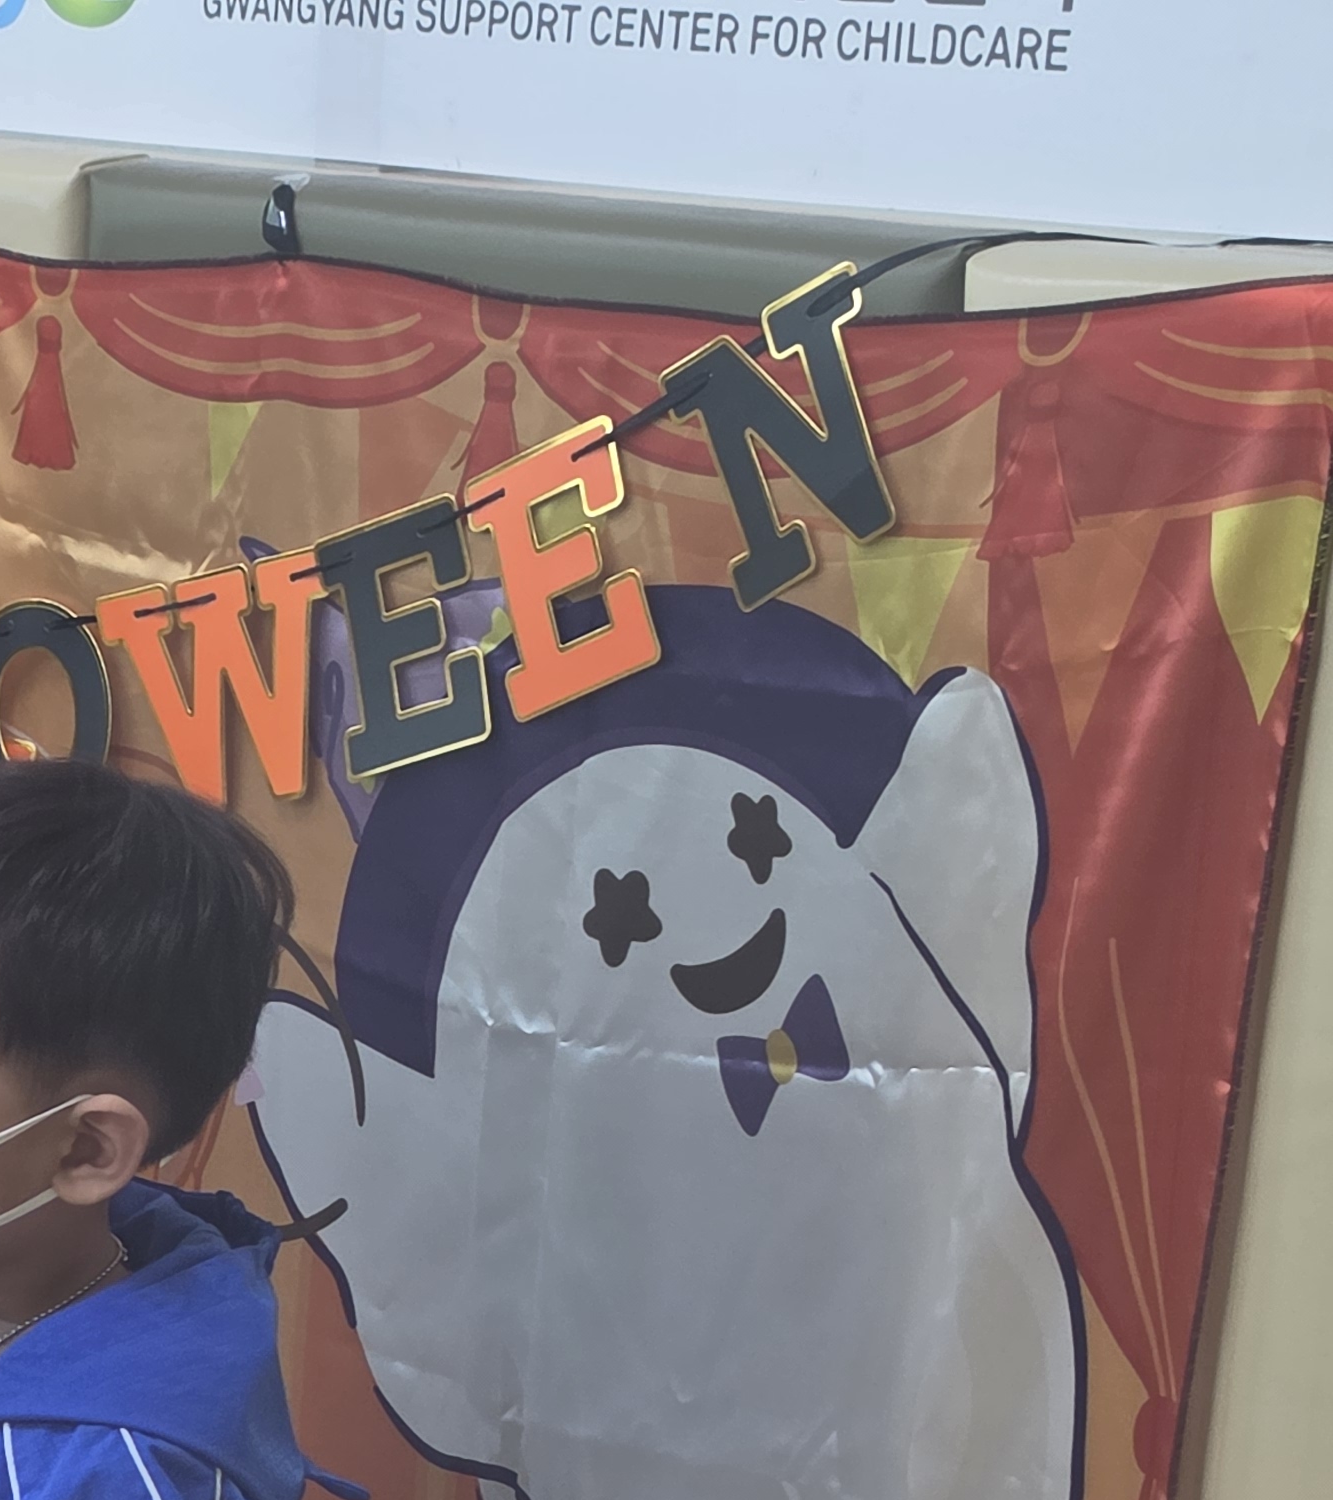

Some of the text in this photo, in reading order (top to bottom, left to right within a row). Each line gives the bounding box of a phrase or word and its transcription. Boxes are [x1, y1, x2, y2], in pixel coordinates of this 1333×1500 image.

[415, 0, 582, 43] SUPPORT
[589, 6, 739, 54] CENTER
[749, 15, 826, 59] FOR
[836, 19, 1071, 71] CHILDCARE
